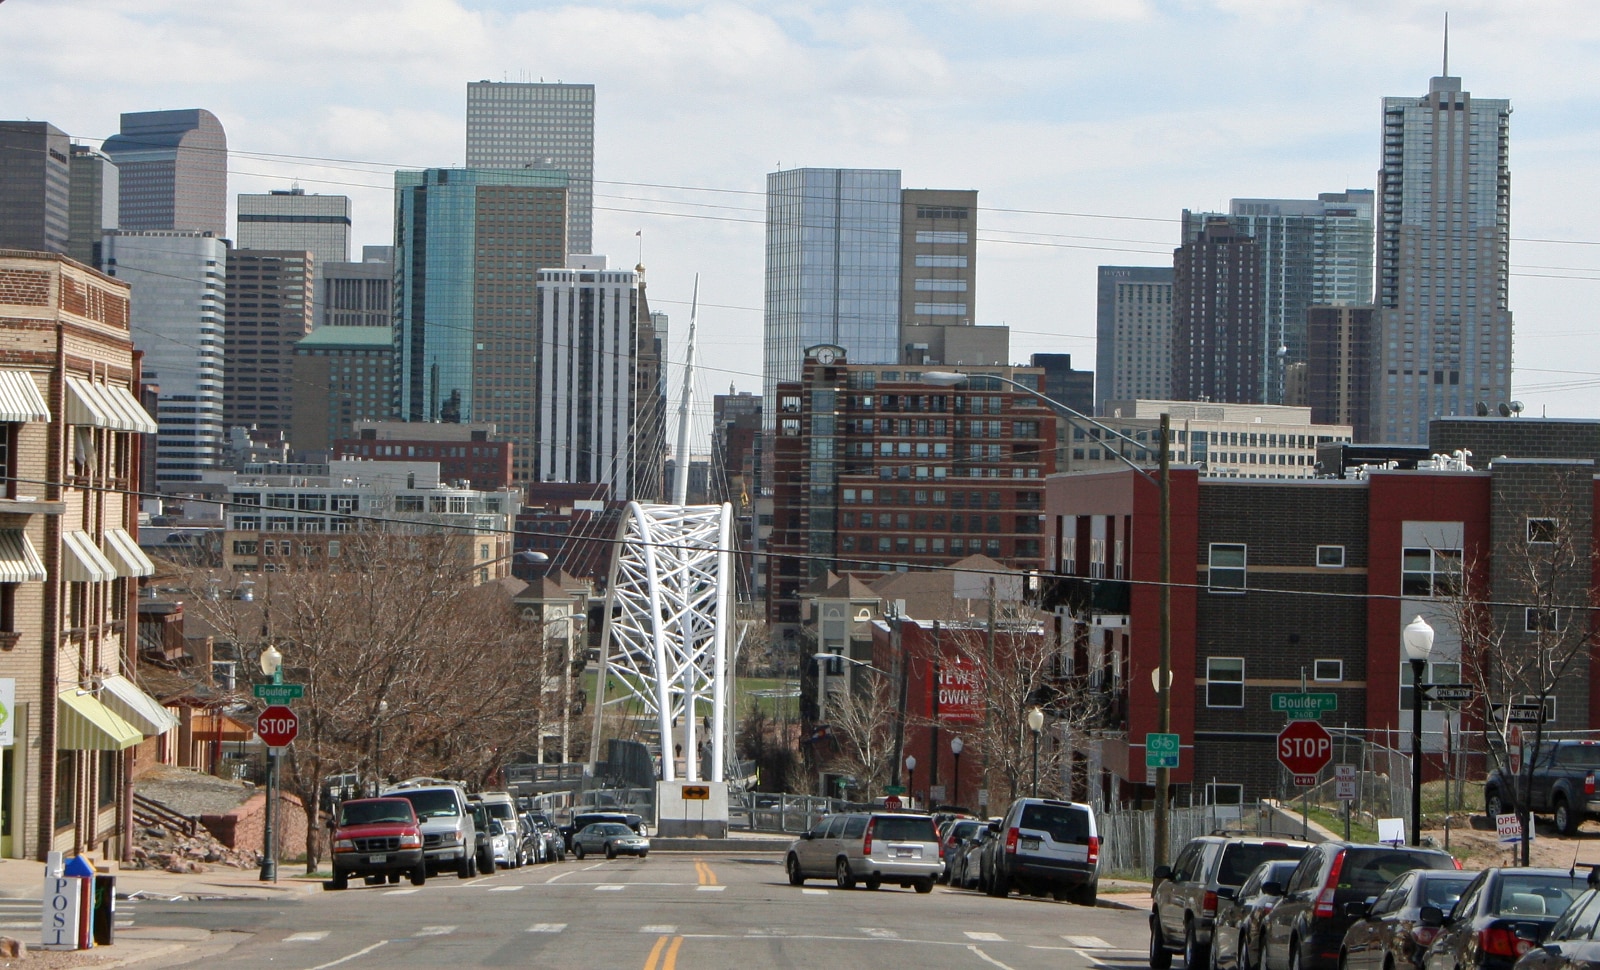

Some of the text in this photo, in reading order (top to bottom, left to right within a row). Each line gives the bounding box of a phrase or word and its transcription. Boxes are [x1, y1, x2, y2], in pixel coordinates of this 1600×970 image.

[259, 686, 292, 696] Boulder
[939, 689, 969, 705] OWN
[1437, 688, 1468, 696] ONE WAY
[1278, 696, 1322, 708] Boulder
[260, 719, 296, 734] STOP
[1281, 738, 1329, 758] STOP
[1498, 826, 1523, 835] HOUS
[53, 879, 67, 945] POST
